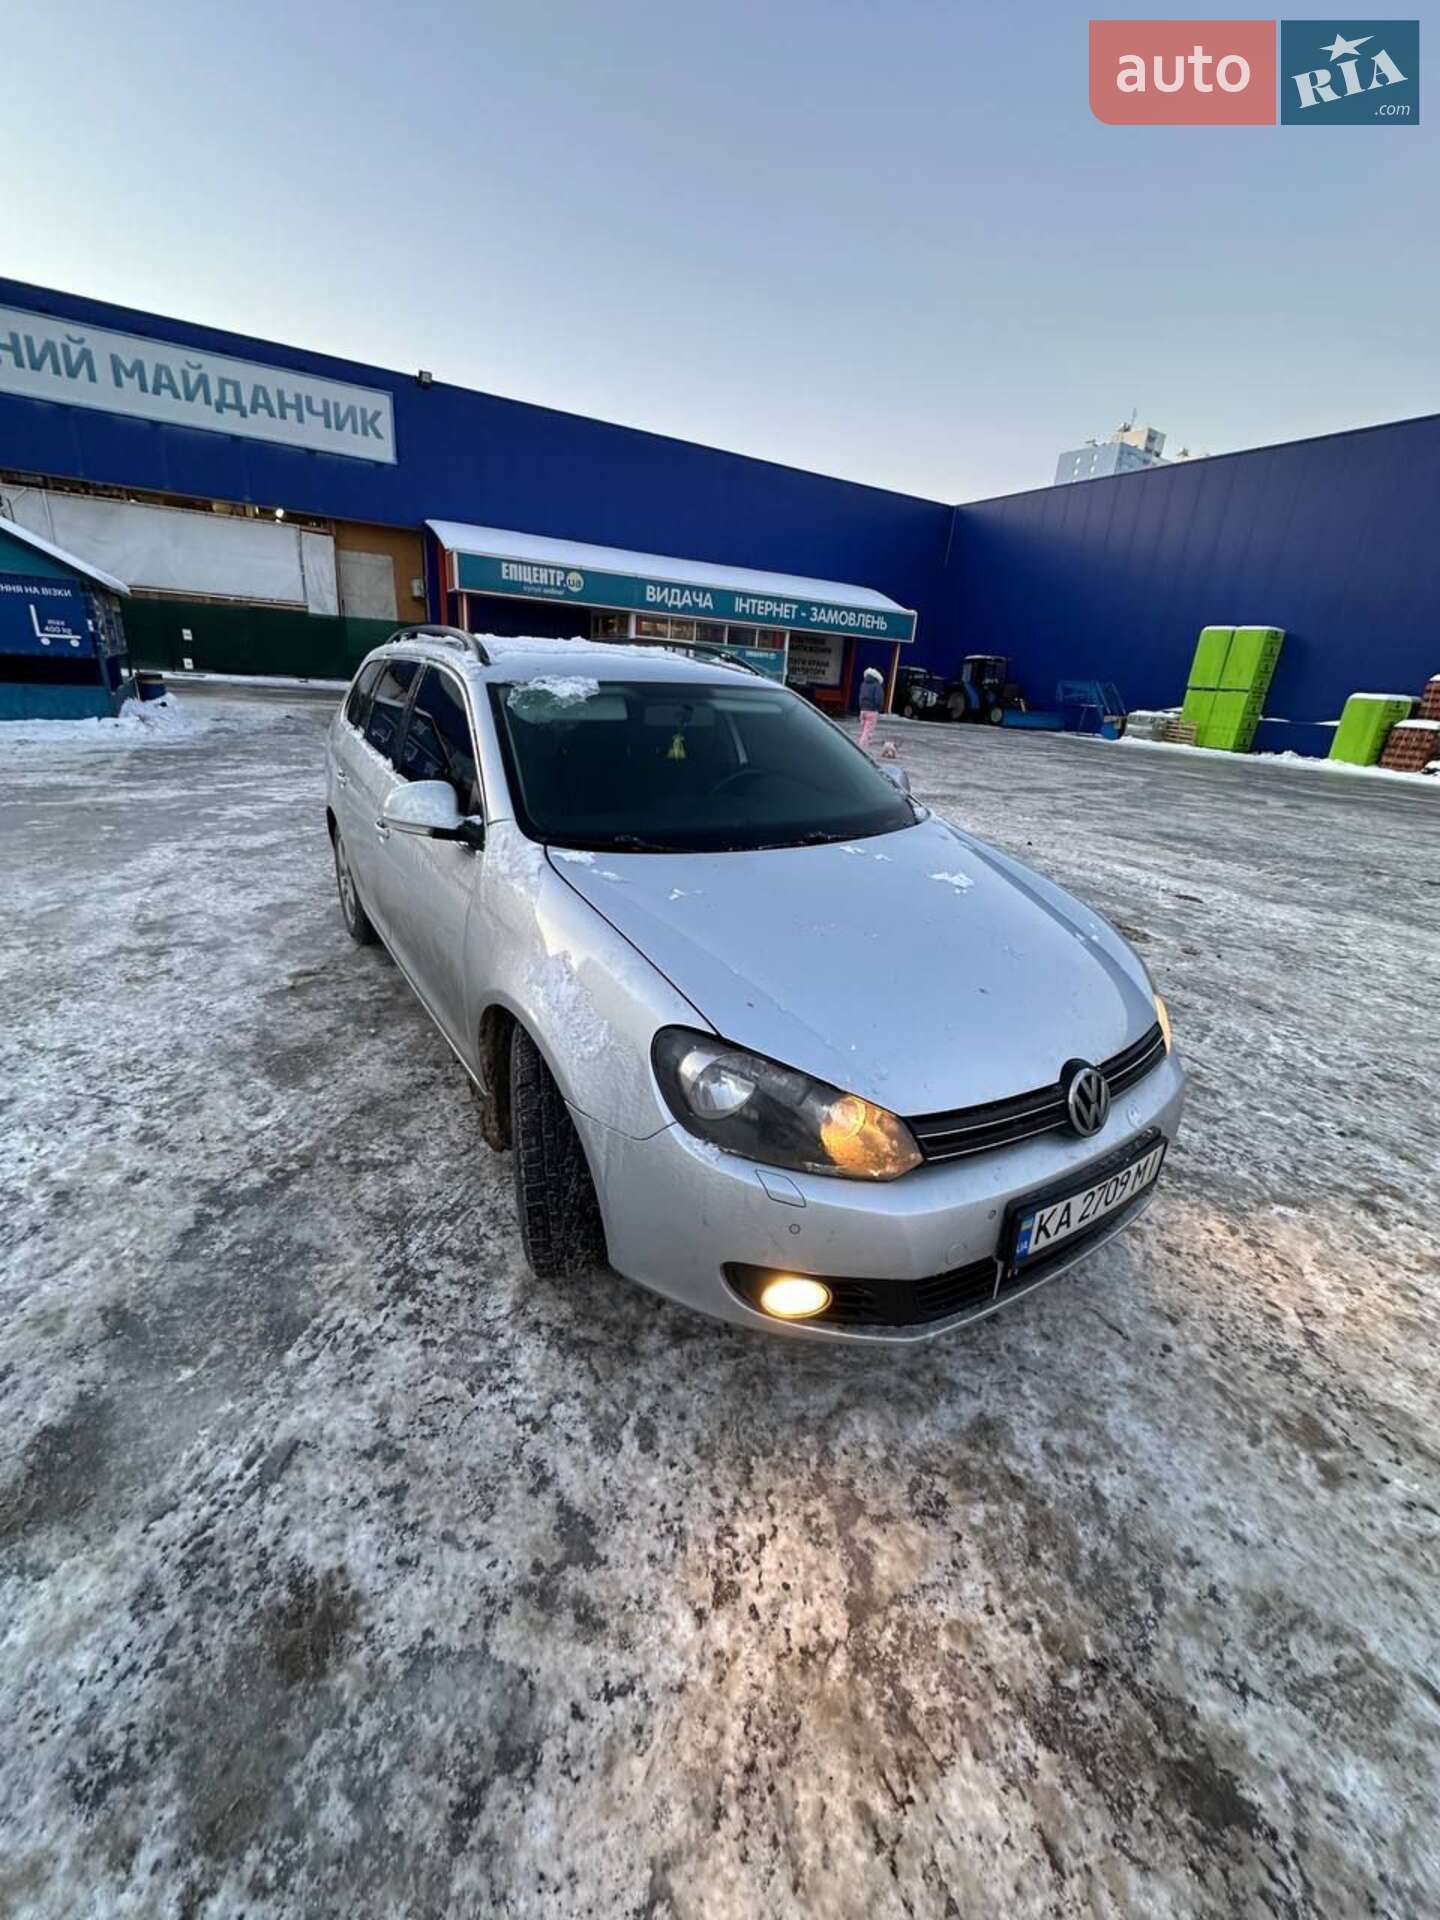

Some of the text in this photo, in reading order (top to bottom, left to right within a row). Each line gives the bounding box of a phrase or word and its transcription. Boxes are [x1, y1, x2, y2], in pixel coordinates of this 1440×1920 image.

[110, 353, 385, 440] МАЙДАНЧИК
[645, 585, 714, 609] ВИДАЧА
[734, 597, 799, 620] ІНТЕРНЕТ
[809, 606, 889, 631] ЗАМОВЛЕНЬ
[1034, 1202, 1071, 1245] KA
[1078, 1170, 1130, 1223] 2709
